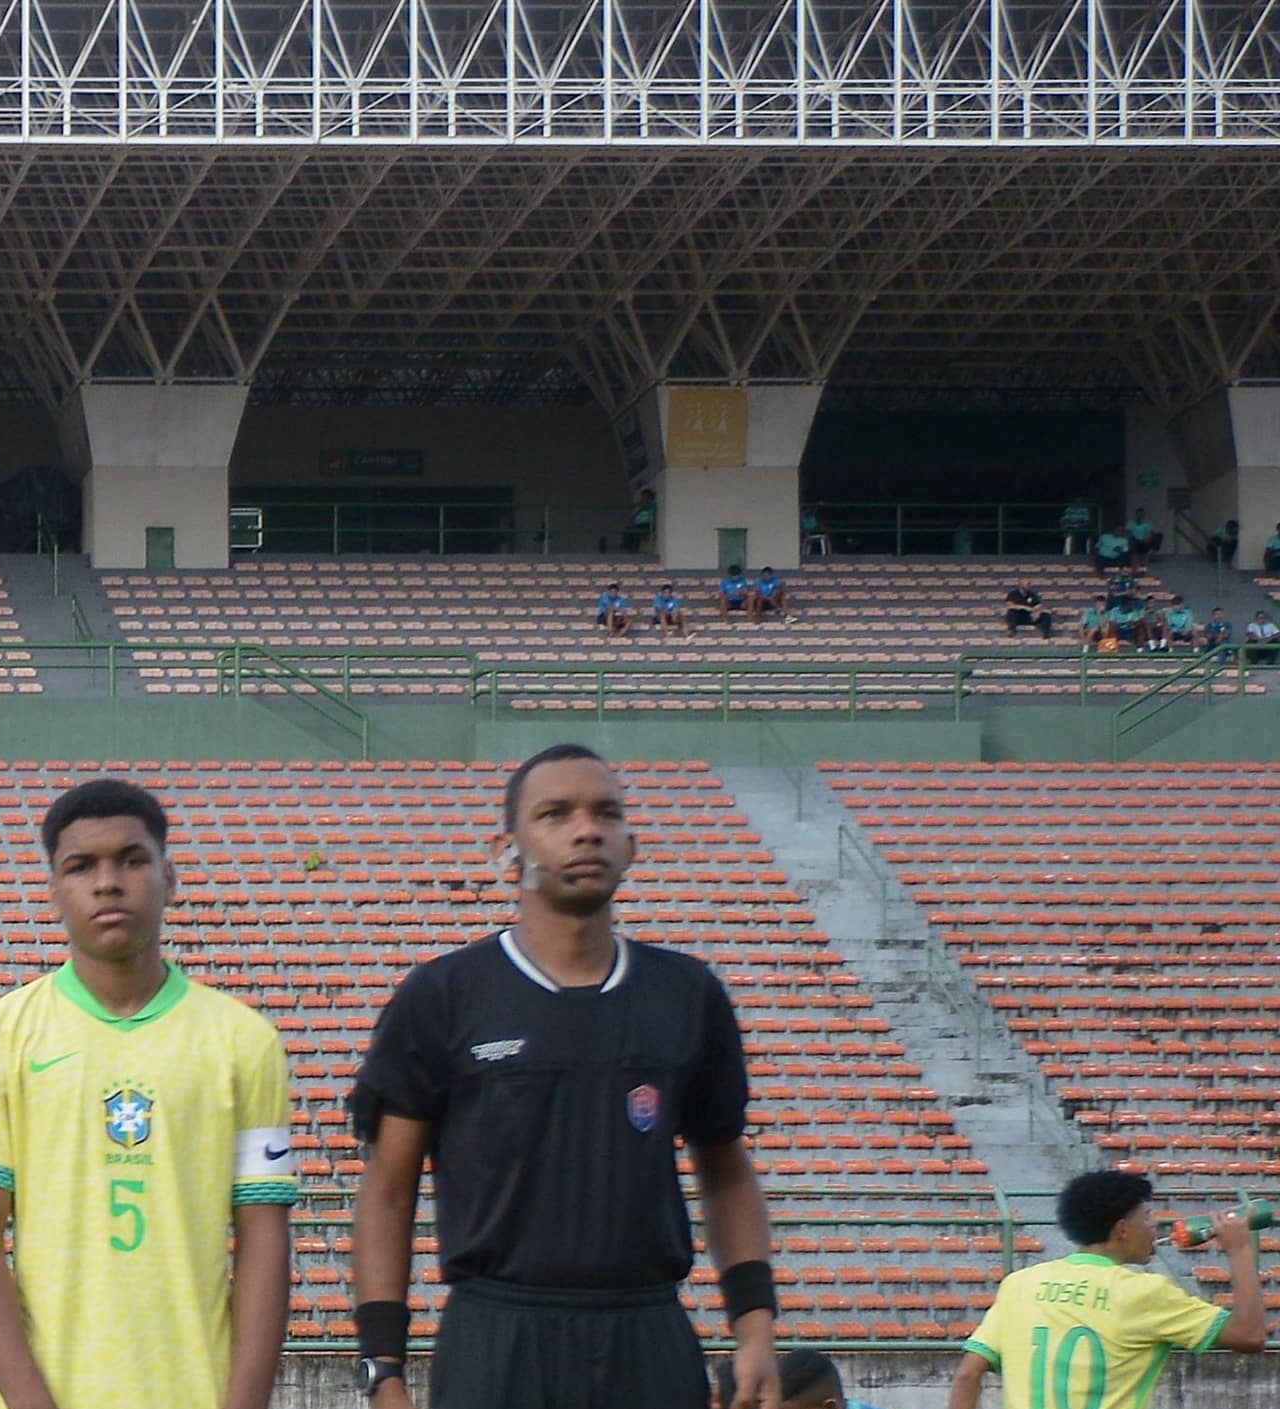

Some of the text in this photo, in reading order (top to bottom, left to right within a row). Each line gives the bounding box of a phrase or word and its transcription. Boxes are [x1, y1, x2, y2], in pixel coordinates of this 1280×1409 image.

[109, 1179, 146, 1252] 5
[1035, 1280, 1111, 1311] JOSÉ H.
